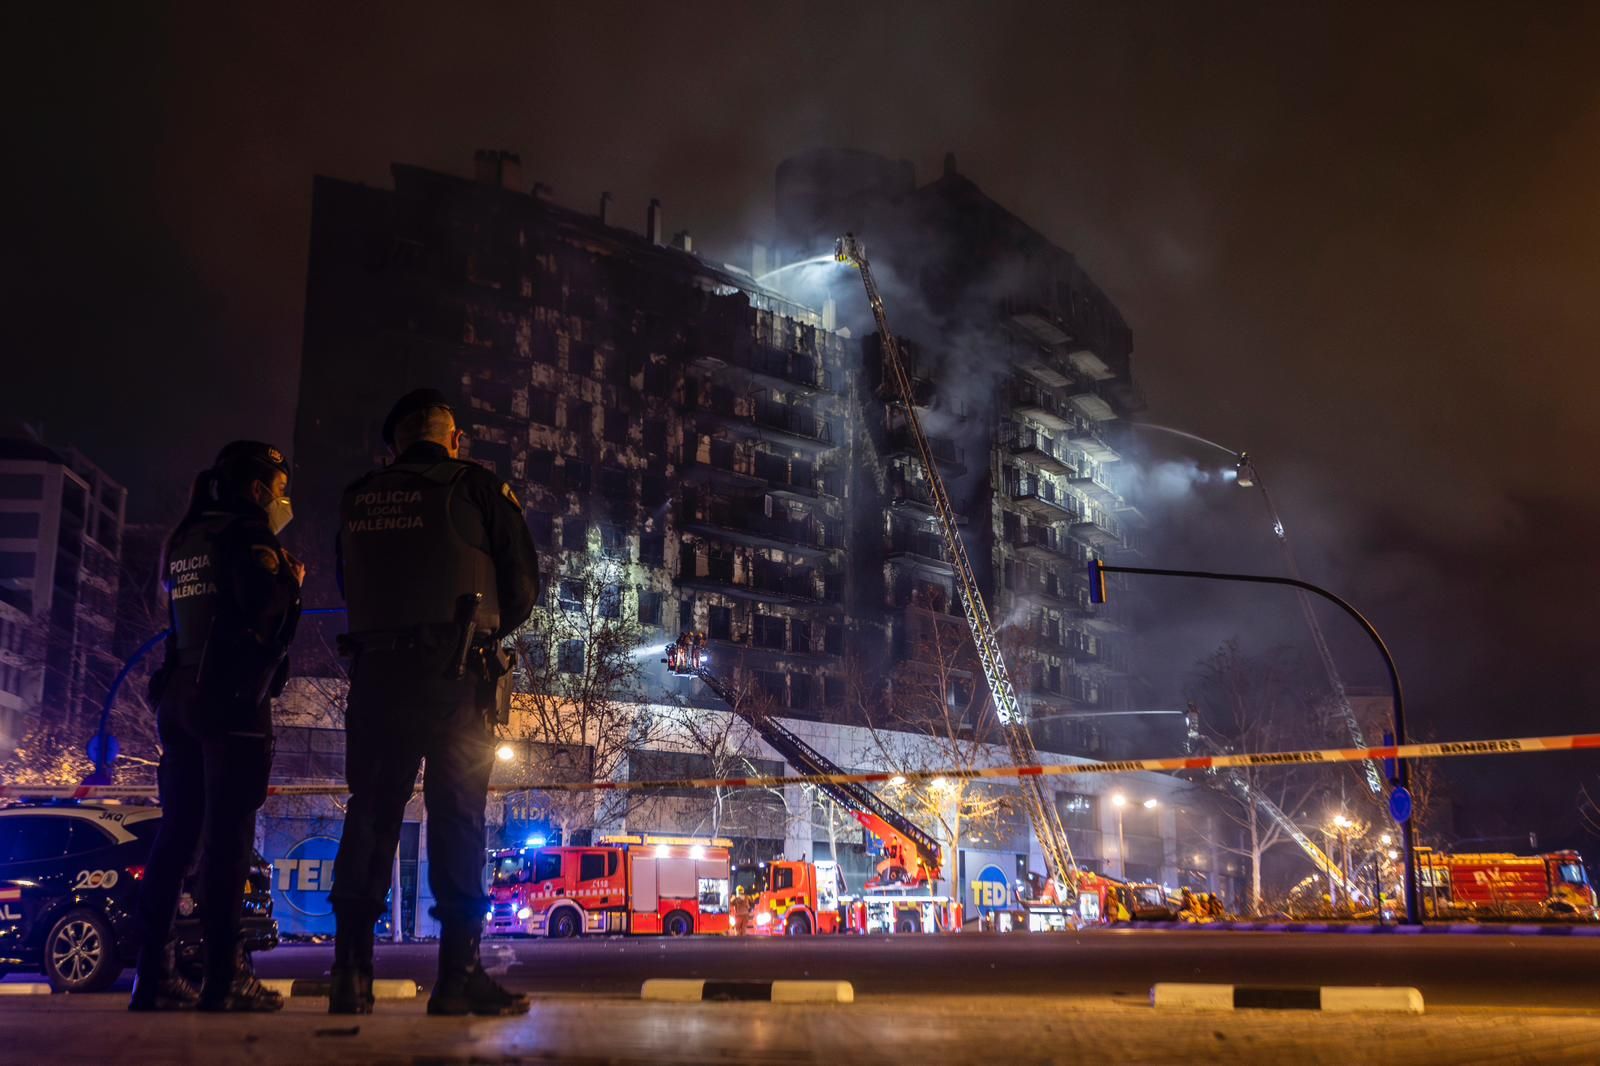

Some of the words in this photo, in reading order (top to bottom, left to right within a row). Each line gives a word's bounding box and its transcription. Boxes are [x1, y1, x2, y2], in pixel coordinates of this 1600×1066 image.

[353, 490, 422, 506] POLICIA
[367, 505, 403, 517] LOCAL
[170, 554, 211, 575] POLICIA
[177, 571, 200, 585] LOCAL
[1439, 740, 1521, 754] BOMBERS
[1249, 751, 1324, 764] BOMBERS
[1077, 761, 1144, 773] BOMBERS
[74, 869, 119, 890] 200
